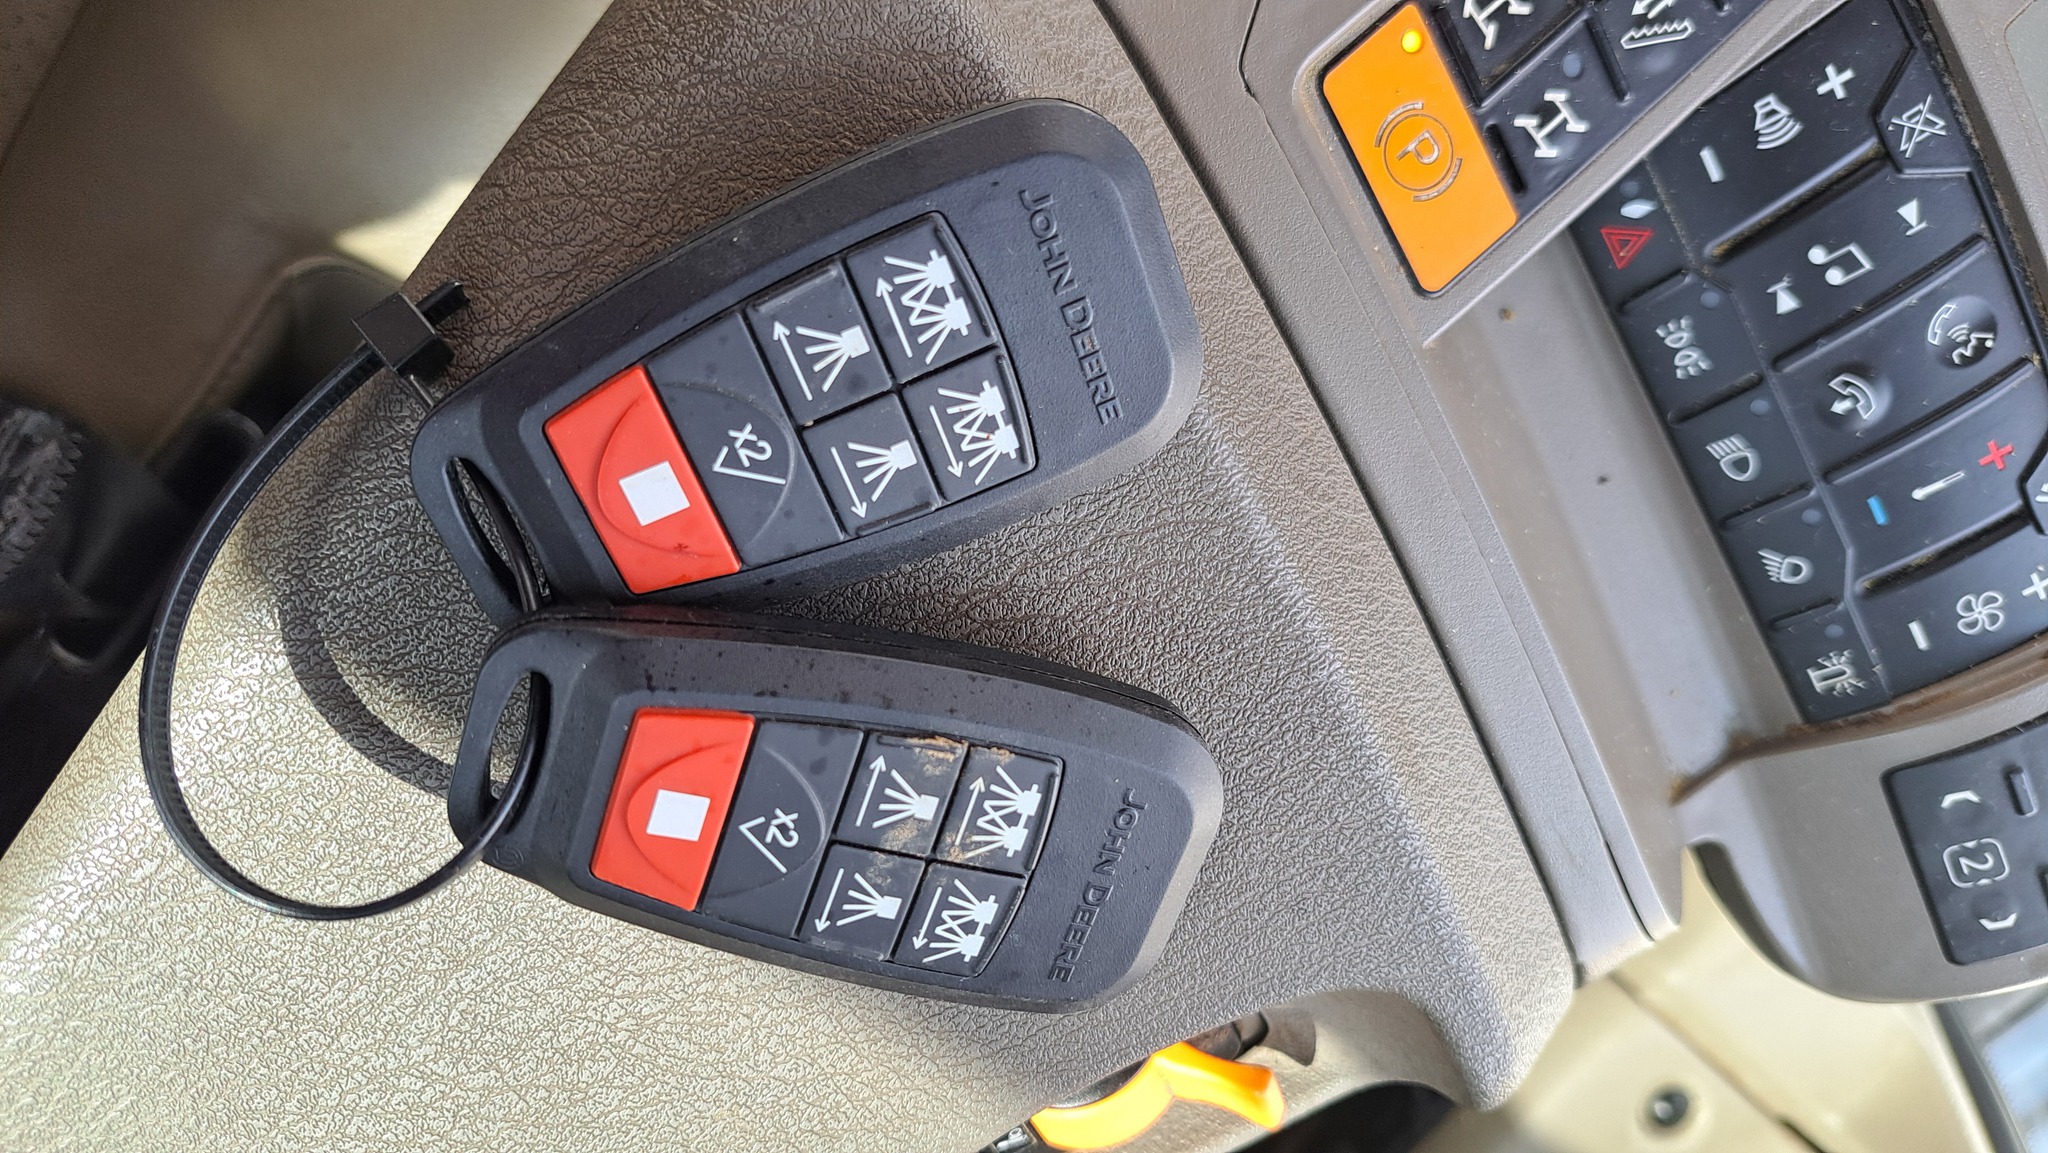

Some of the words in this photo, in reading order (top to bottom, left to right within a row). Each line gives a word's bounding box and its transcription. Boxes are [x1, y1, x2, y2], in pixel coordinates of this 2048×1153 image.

[1396, 130, 1440, 165] P
[1018, 189, 1079, 296] JOHN
[1060, 296, 1124, 426] DEERE
[1093, 788, 1148, 876] JOHN
[1959, 851, 1994, 876] 2
[1049, 880, 1114, 983] DEERE
